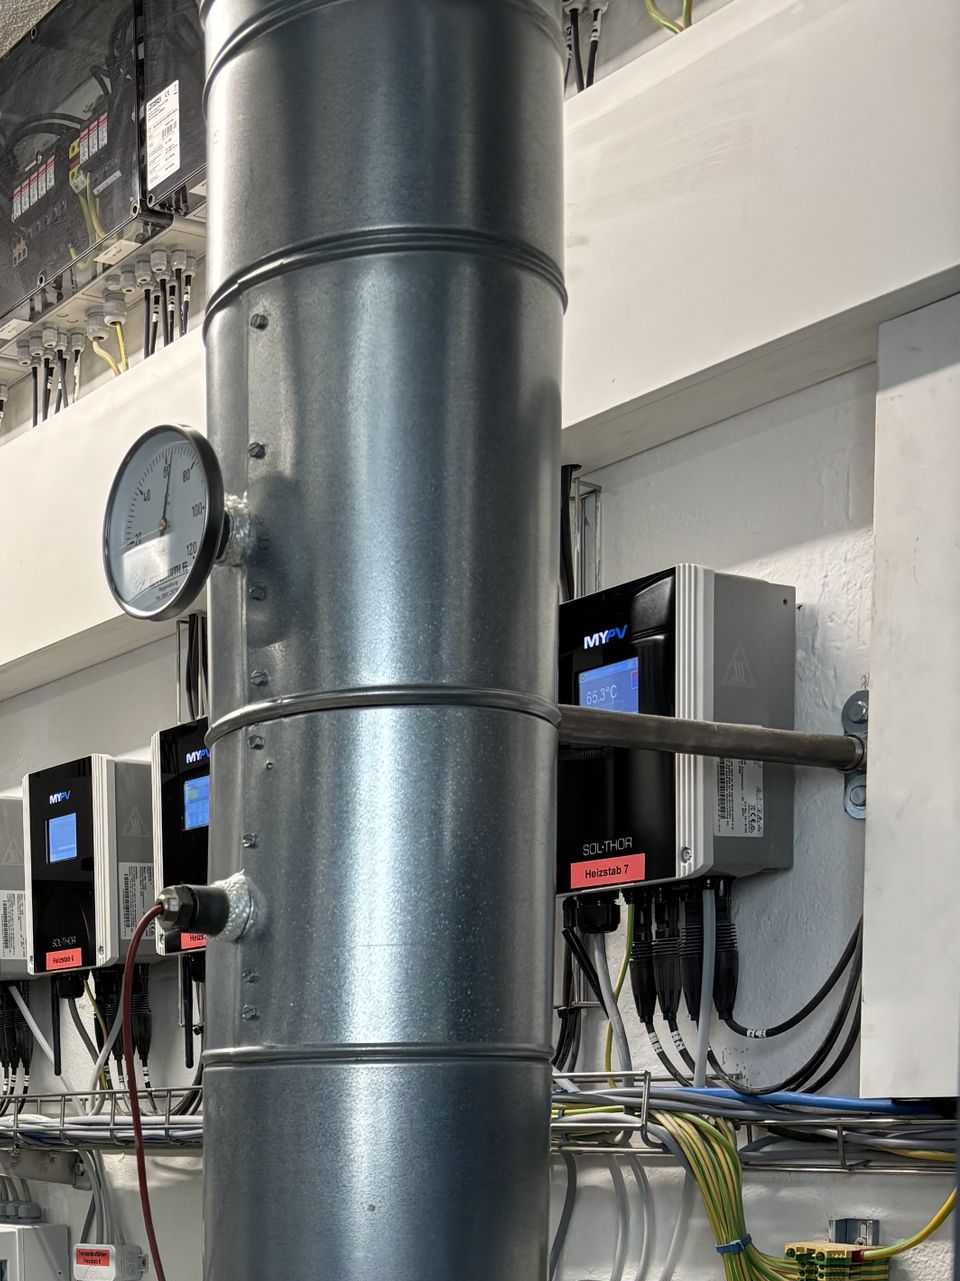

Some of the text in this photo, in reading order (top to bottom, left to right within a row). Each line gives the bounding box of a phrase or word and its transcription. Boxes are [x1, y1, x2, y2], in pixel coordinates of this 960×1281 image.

[583, 624, 628, 650] MYPV
[586, 684, 618, 705] 65.3°C
[584, 864, 629, 879] Heizstab 7
